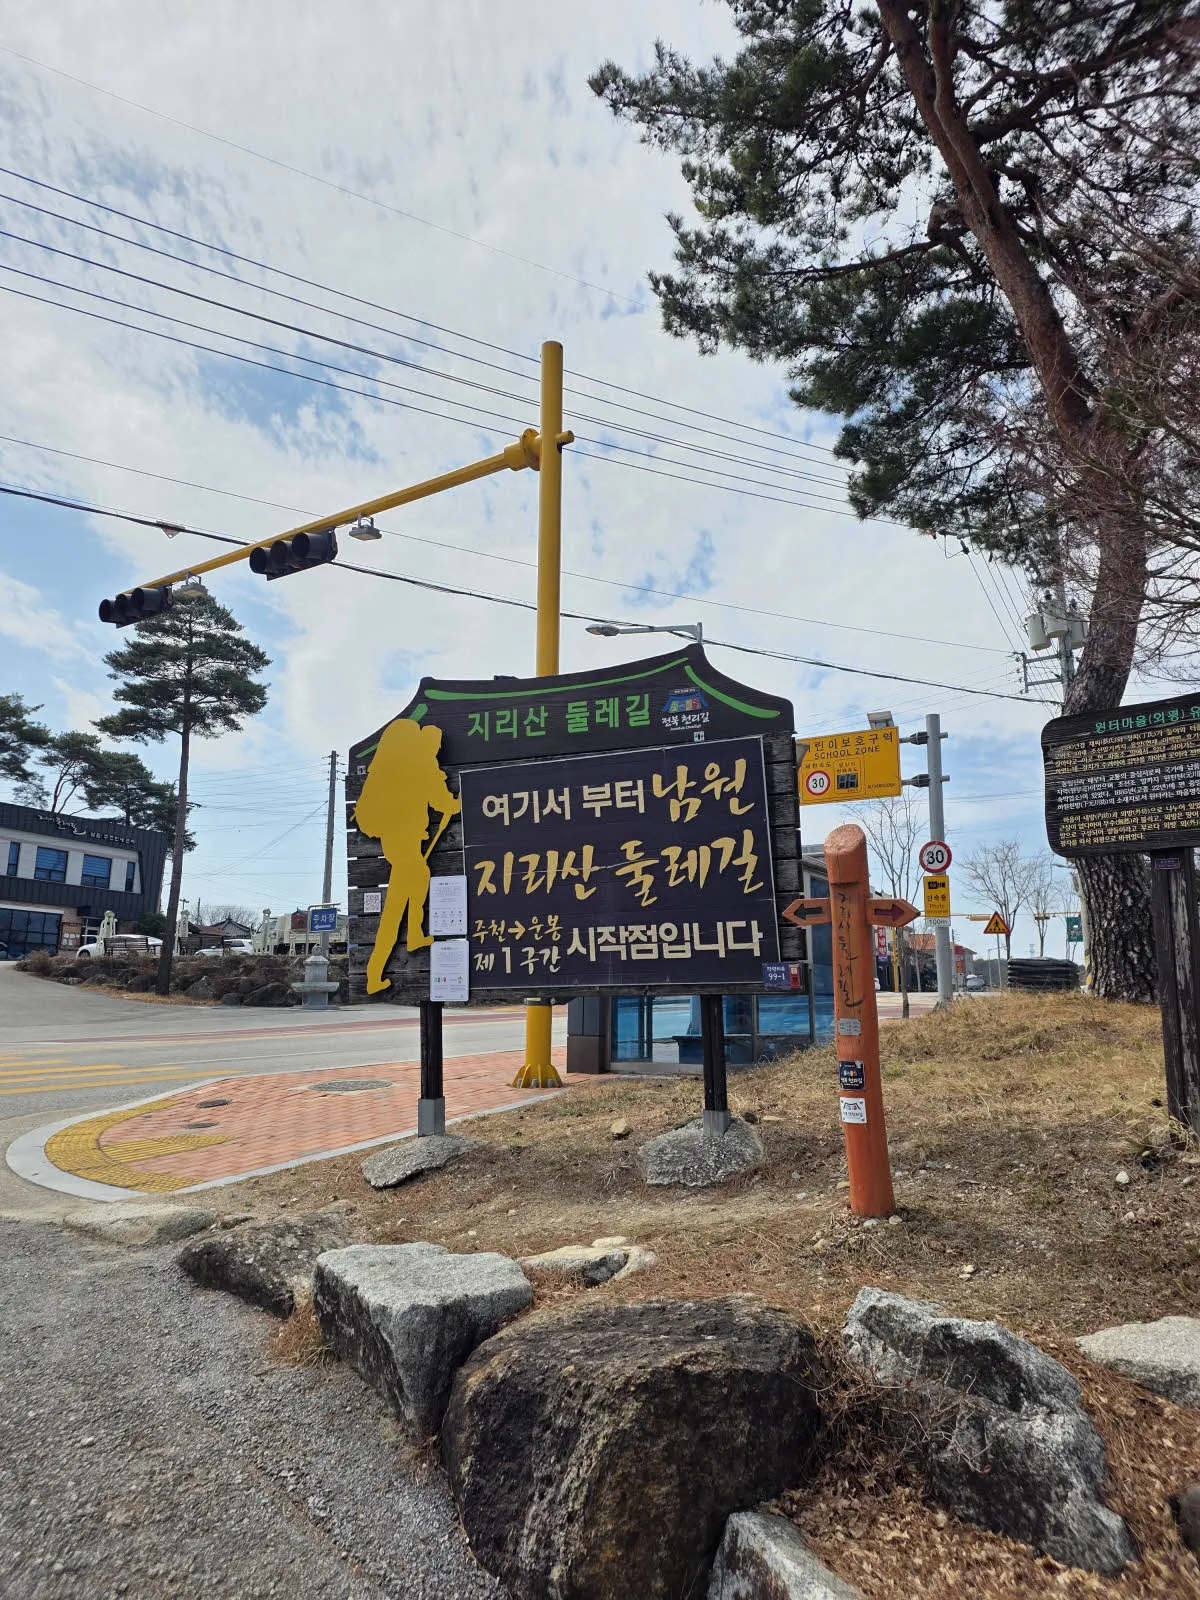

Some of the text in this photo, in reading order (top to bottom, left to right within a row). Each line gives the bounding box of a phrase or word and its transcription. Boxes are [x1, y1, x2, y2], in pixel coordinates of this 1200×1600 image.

[467, 693, 650, 741] 지리산 둘레길
[662, 711, 709, 727] 전북 천리길
[808, 731, 893, 752] 린이보호구역
[814, 745, 880, 760] SCHOOL ZONE
[812, 777, 825, 788] 30
[482, 758, 755, 826] 여기서 부터 남원
[926, 850, 944, 865] 30
[474, 829, 764, 907] 지리산 둘레길
[313, 913, 335, 924] 주차장
[472, 914, 564, 945] 주천 운봉
[474, 919, 763, 975] 제 1 구간 시작점입니다
[768, 972, 785, 980] 99-1
